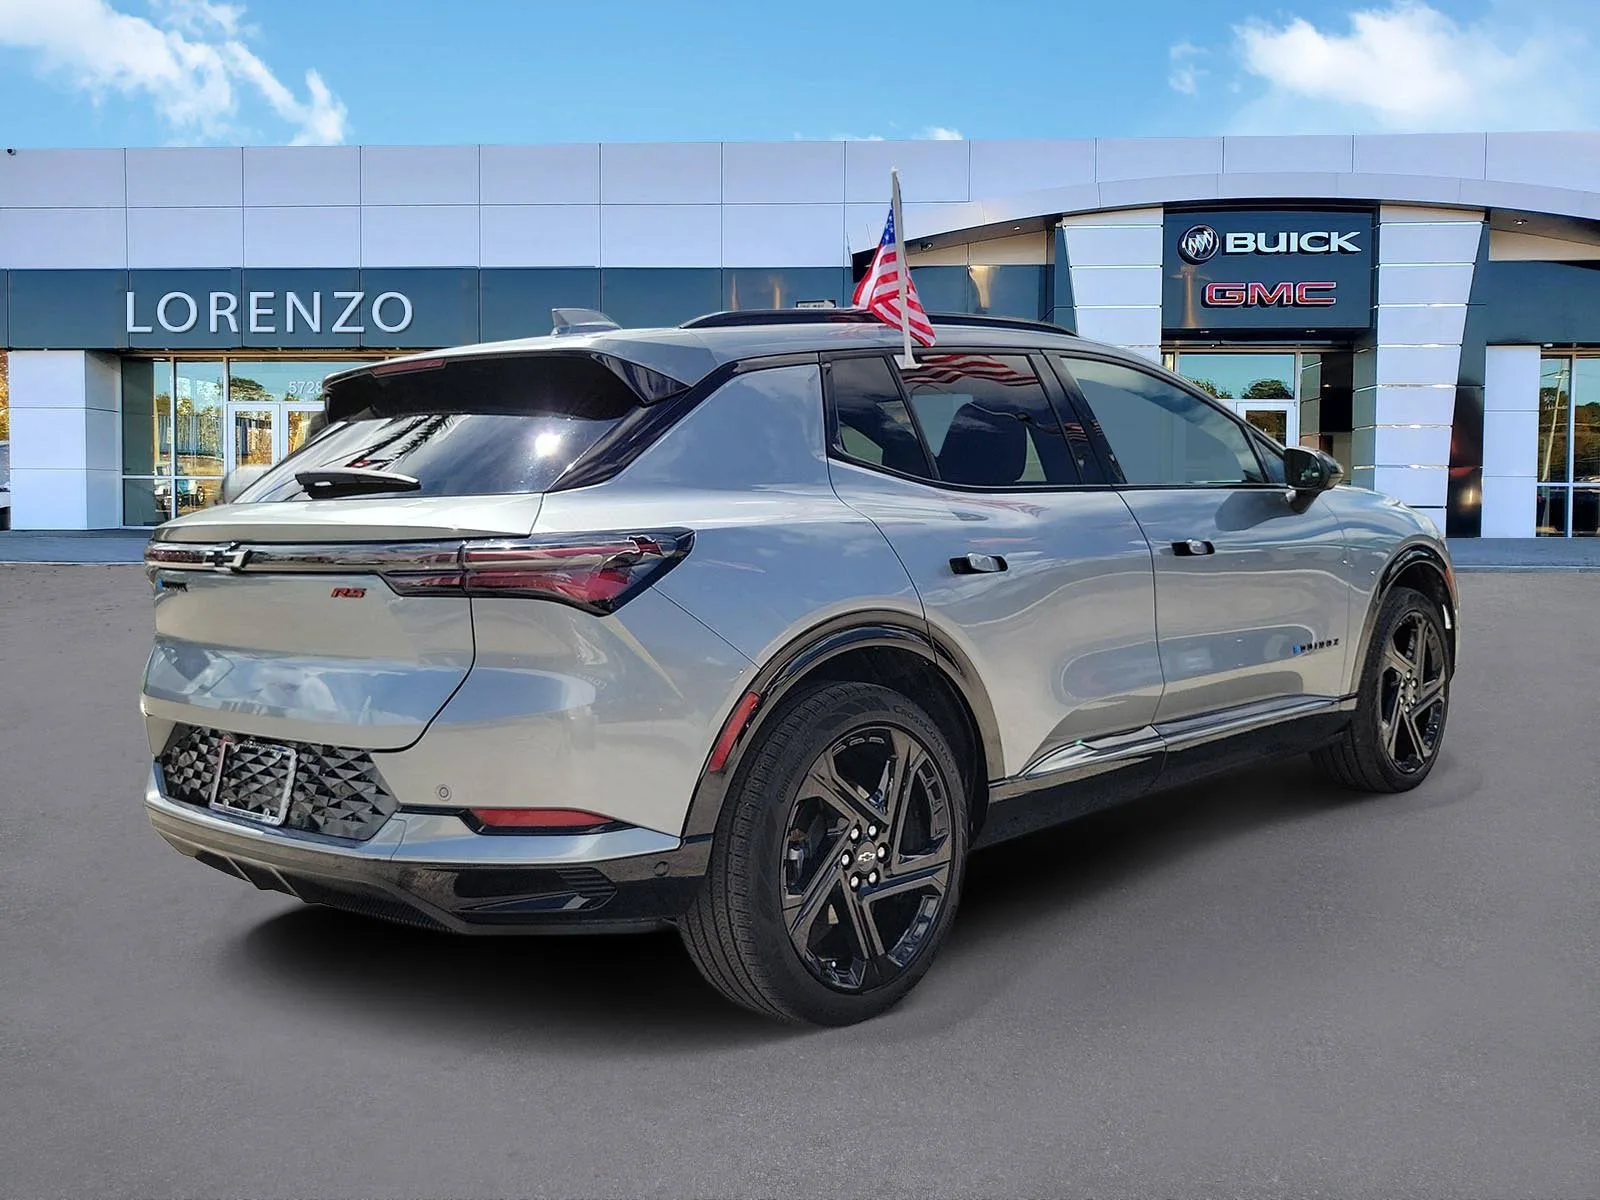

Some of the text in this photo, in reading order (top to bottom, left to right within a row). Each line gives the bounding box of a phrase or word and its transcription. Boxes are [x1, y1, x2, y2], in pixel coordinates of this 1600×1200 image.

[1225, 231, 1362, 253] BUICK
[1205, 282, 1337, 305] GMC
[126, 291, 413, 333] LORENZO
[288, 381, 323, 394] 5728
[331, 587, 367, 598] RS
